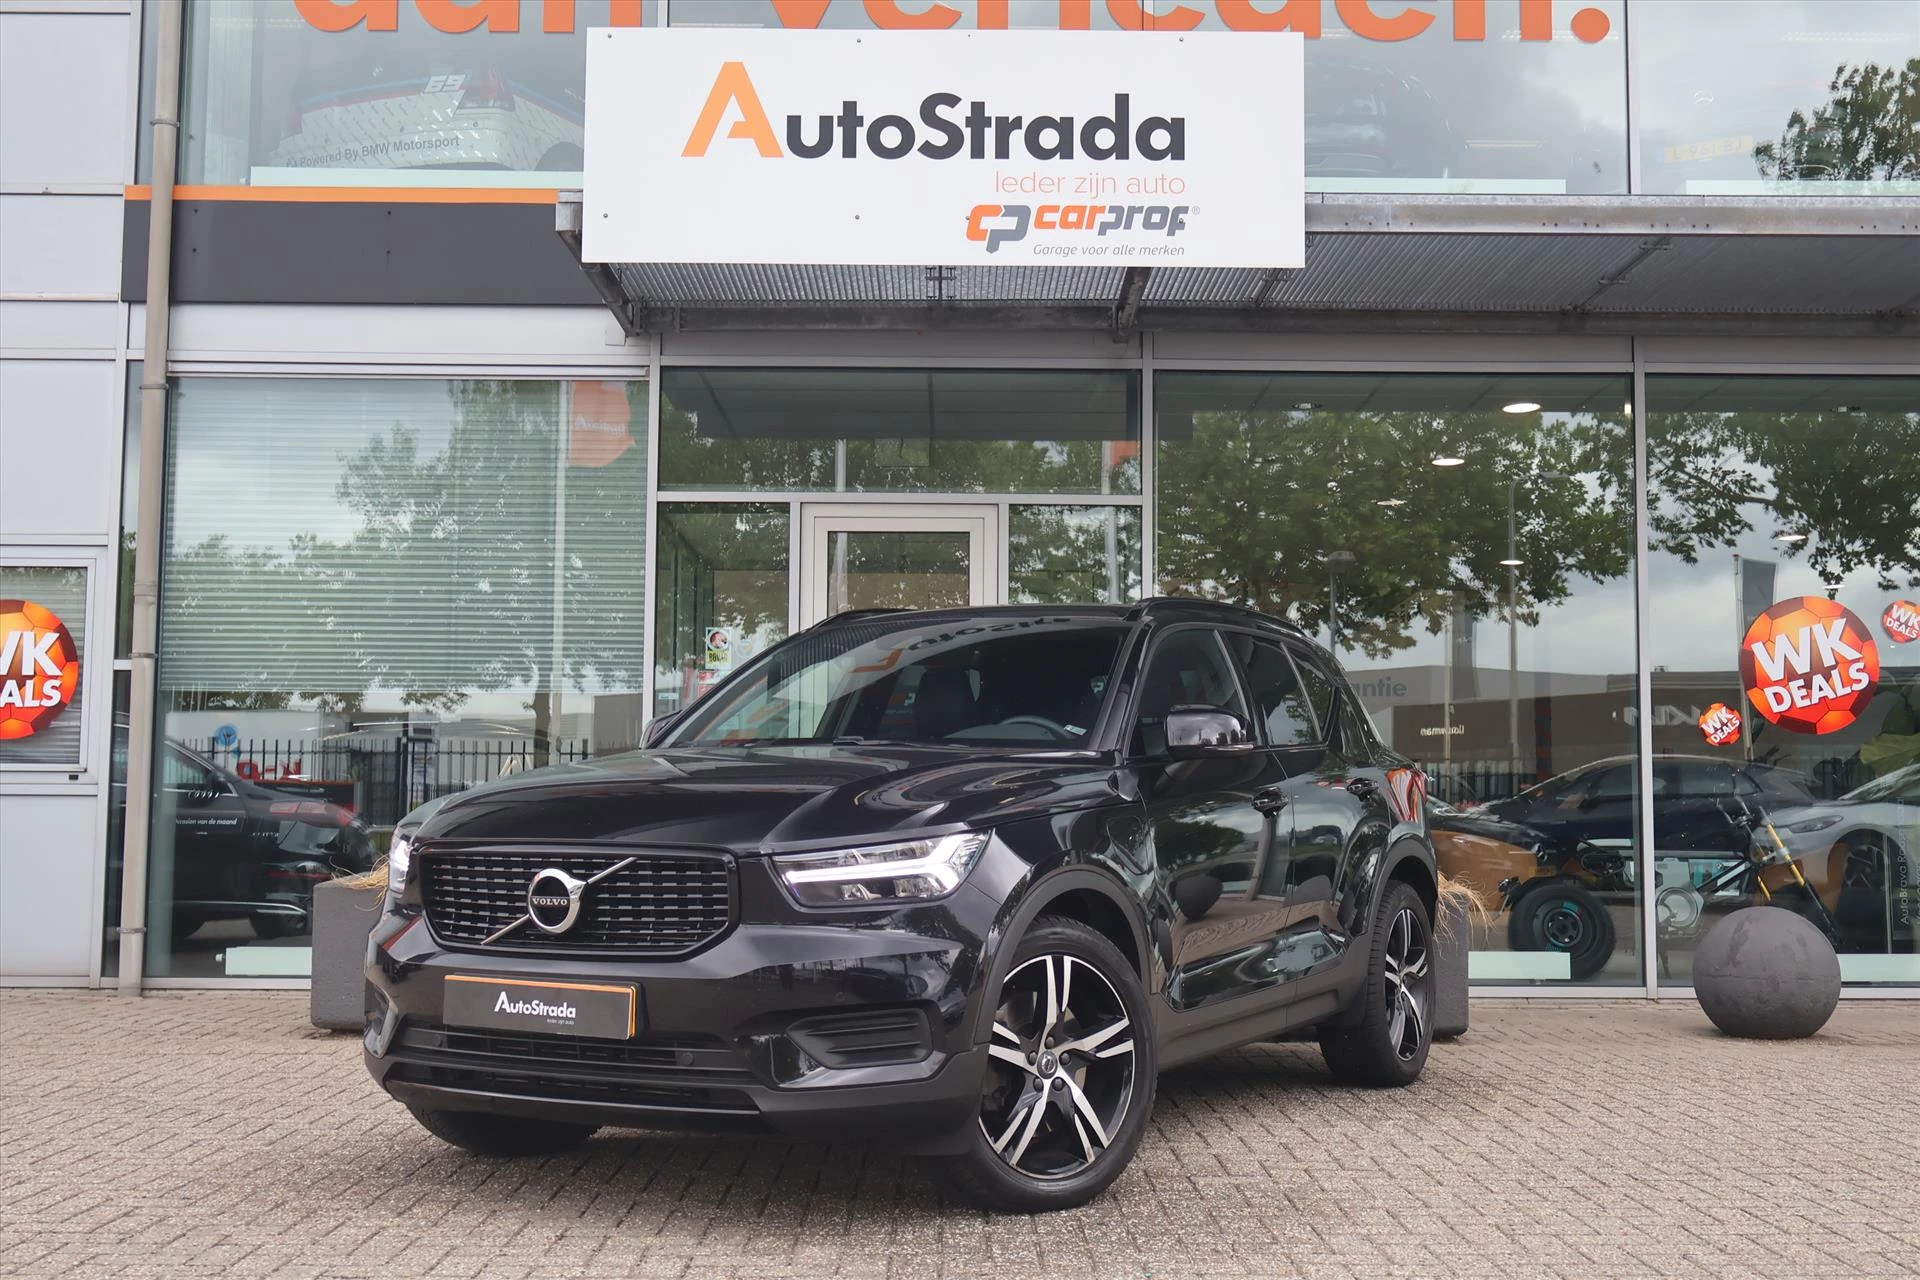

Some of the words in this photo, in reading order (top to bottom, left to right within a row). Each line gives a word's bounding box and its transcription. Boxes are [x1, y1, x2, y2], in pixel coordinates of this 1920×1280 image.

[681, 61, 1185, 161] AutoStrada
[344, 149, 358, 161] By
[362, 142, 391, 158] BMW
[392, 135, 460, 153] Motorsport
[995, 171, 1066, 194] Ieder
[1074, 172, 1116, 199] zijn
[1126, 174, 1186, 195] auto
[1033, 243, 1078, 258] Garage
[1082, 246, 1109, 256] voor
[1112, 244, 1136, 256] alle
[1139, 244, 1185, 256] merken
[1886, 618, 1919, 640] DEALS
[1751, 617, 1864, 682] WK
[1763, 661, 1870, 714] DEALS
[1701, 705, 1734, 735] WK
[1710, 716, 1741, 744] DEALS
[531, 898, 568, 906] VOLVO
[494, 991, 576, 1018] AutoStrada
